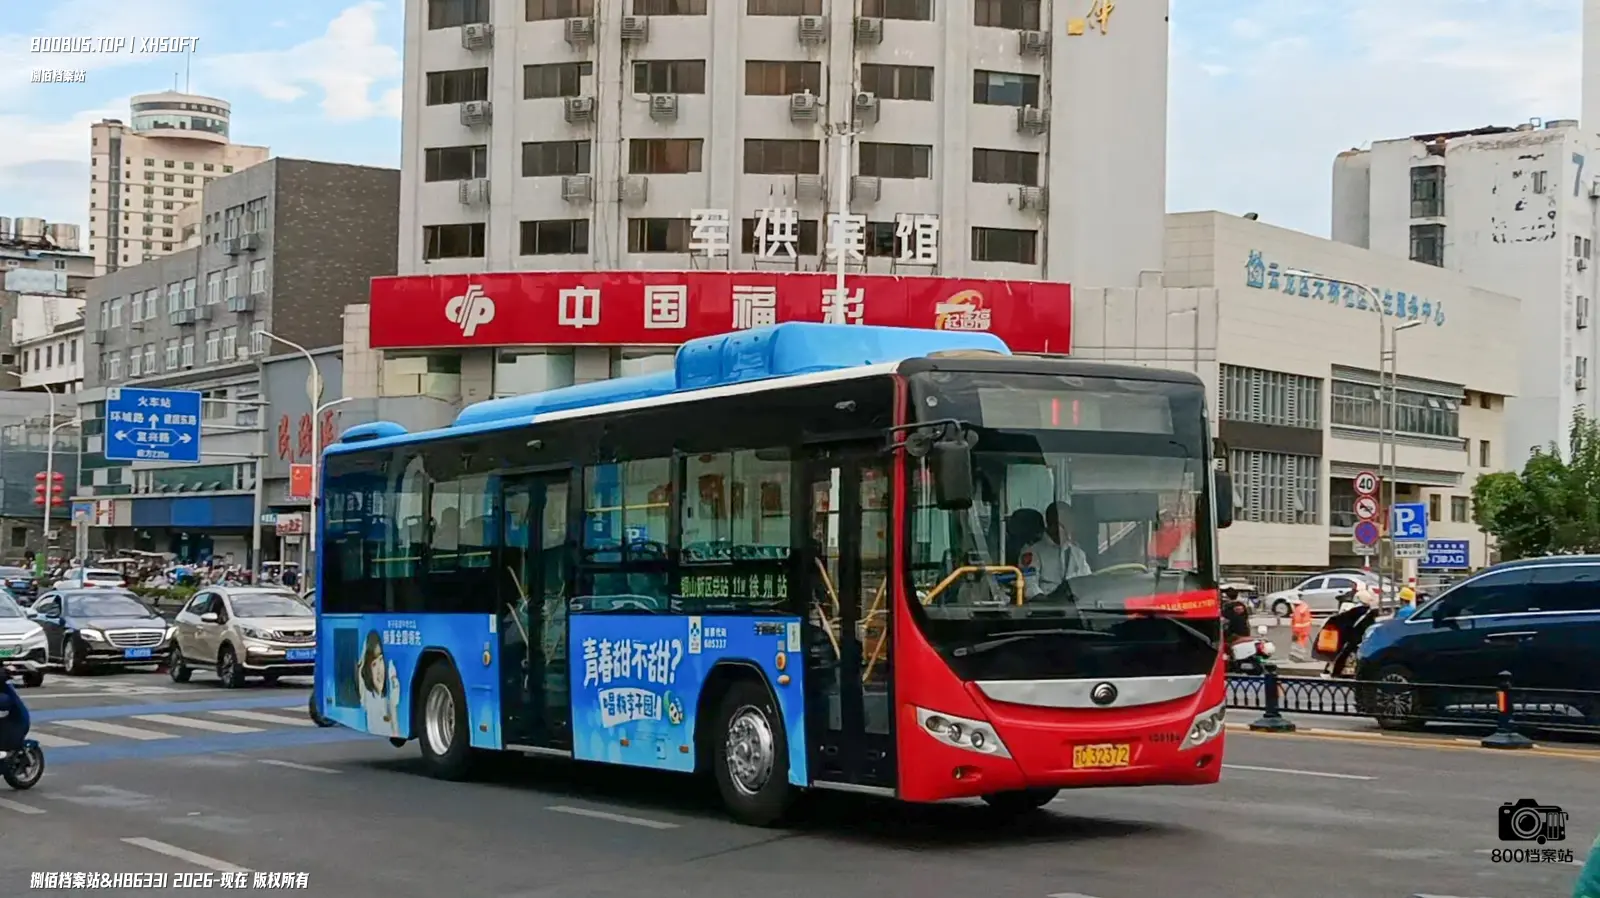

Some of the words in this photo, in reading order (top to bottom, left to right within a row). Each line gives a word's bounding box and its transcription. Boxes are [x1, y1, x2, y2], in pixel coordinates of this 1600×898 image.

[688, 207, 939, 266] 军供宾馆
[558, 284, 865, 328] 中国福彩
[137, 395, 172, 409] 火车站
[1051, 397, 1081, 426] 11
[110, 411, 144, 423] 环城路
[1358, 477, 1374, 491] 40
[1393, 507, 1416, 537] P
[749, 574, 788, 598] 徐州站
[582, 637, 684, 692] 青春甜不甜?
